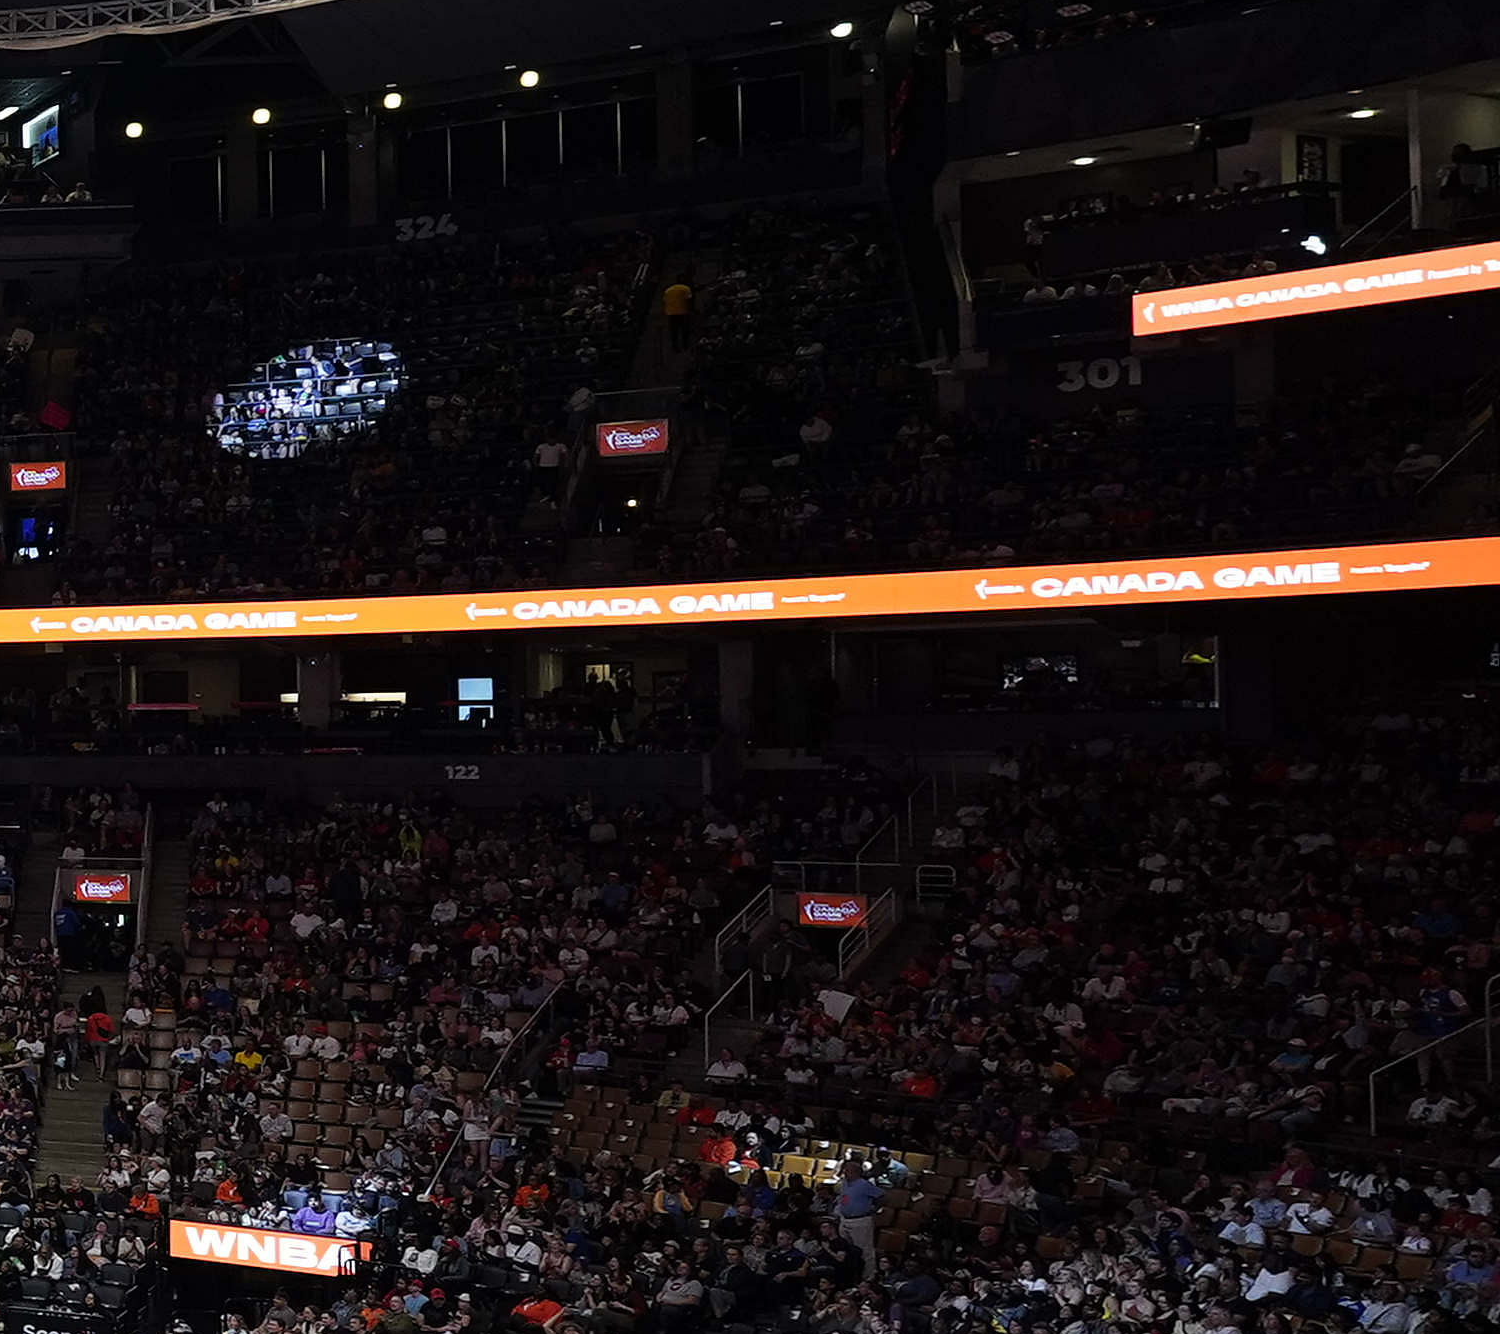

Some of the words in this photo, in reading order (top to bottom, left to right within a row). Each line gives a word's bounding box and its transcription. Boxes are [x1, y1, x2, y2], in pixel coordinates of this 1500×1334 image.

[1161, 295, 1234, 317] WNBA
[1235, 281, 1341, 308] CANADA
[1344, 269, 1424, 292] GAME
[1058, 355, 1143, 391] 301
[1031, 571, 1204, 597] CANADA
[1213, 563, 1340, 588] GAME
[71, 615, 198, 634] CANADA
[204, 611, 297, 630] GAME
[445, 765, 480, 780] 122
[183, 1223, 356, 1273] WNBA
